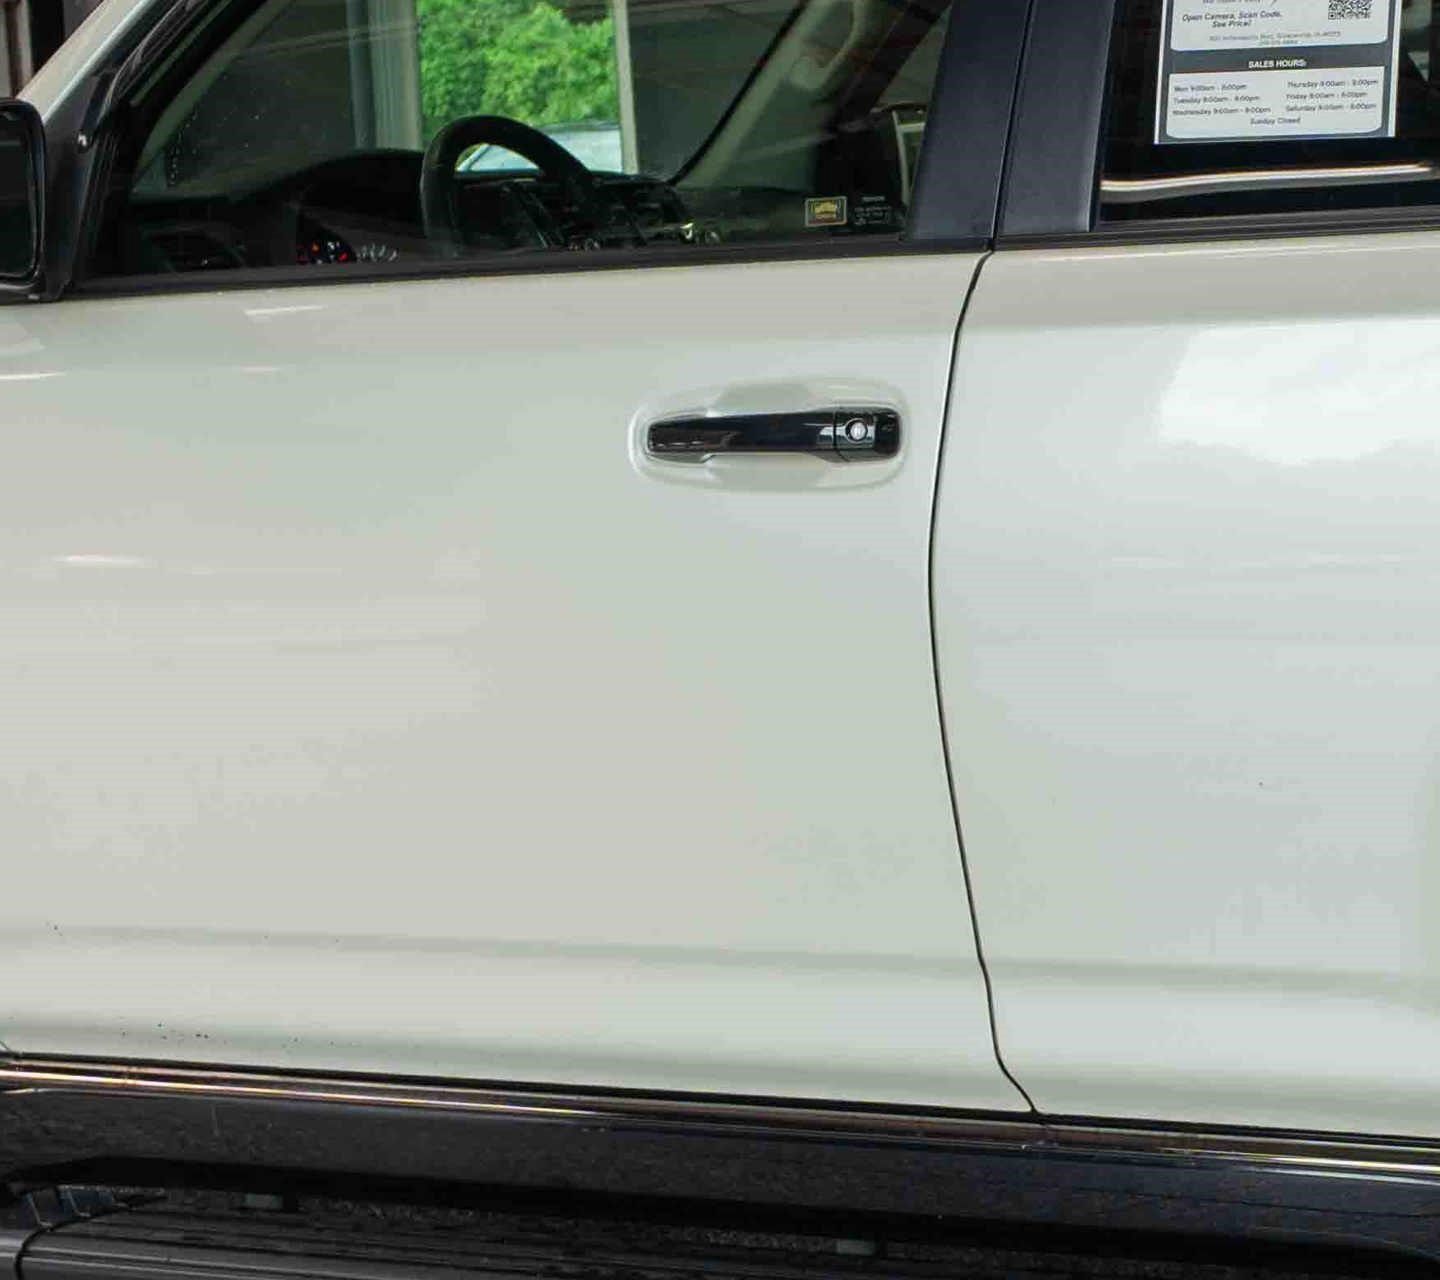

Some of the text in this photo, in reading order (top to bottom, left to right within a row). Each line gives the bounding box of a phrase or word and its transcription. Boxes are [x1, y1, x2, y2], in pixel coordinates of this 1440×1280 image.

[1182, 13, 1203, 22] Open
[1238, 10, 1258, 19] Scan
[1212, 21, 1226, 29] See
[1248, 60, 1274, 69] SALES
